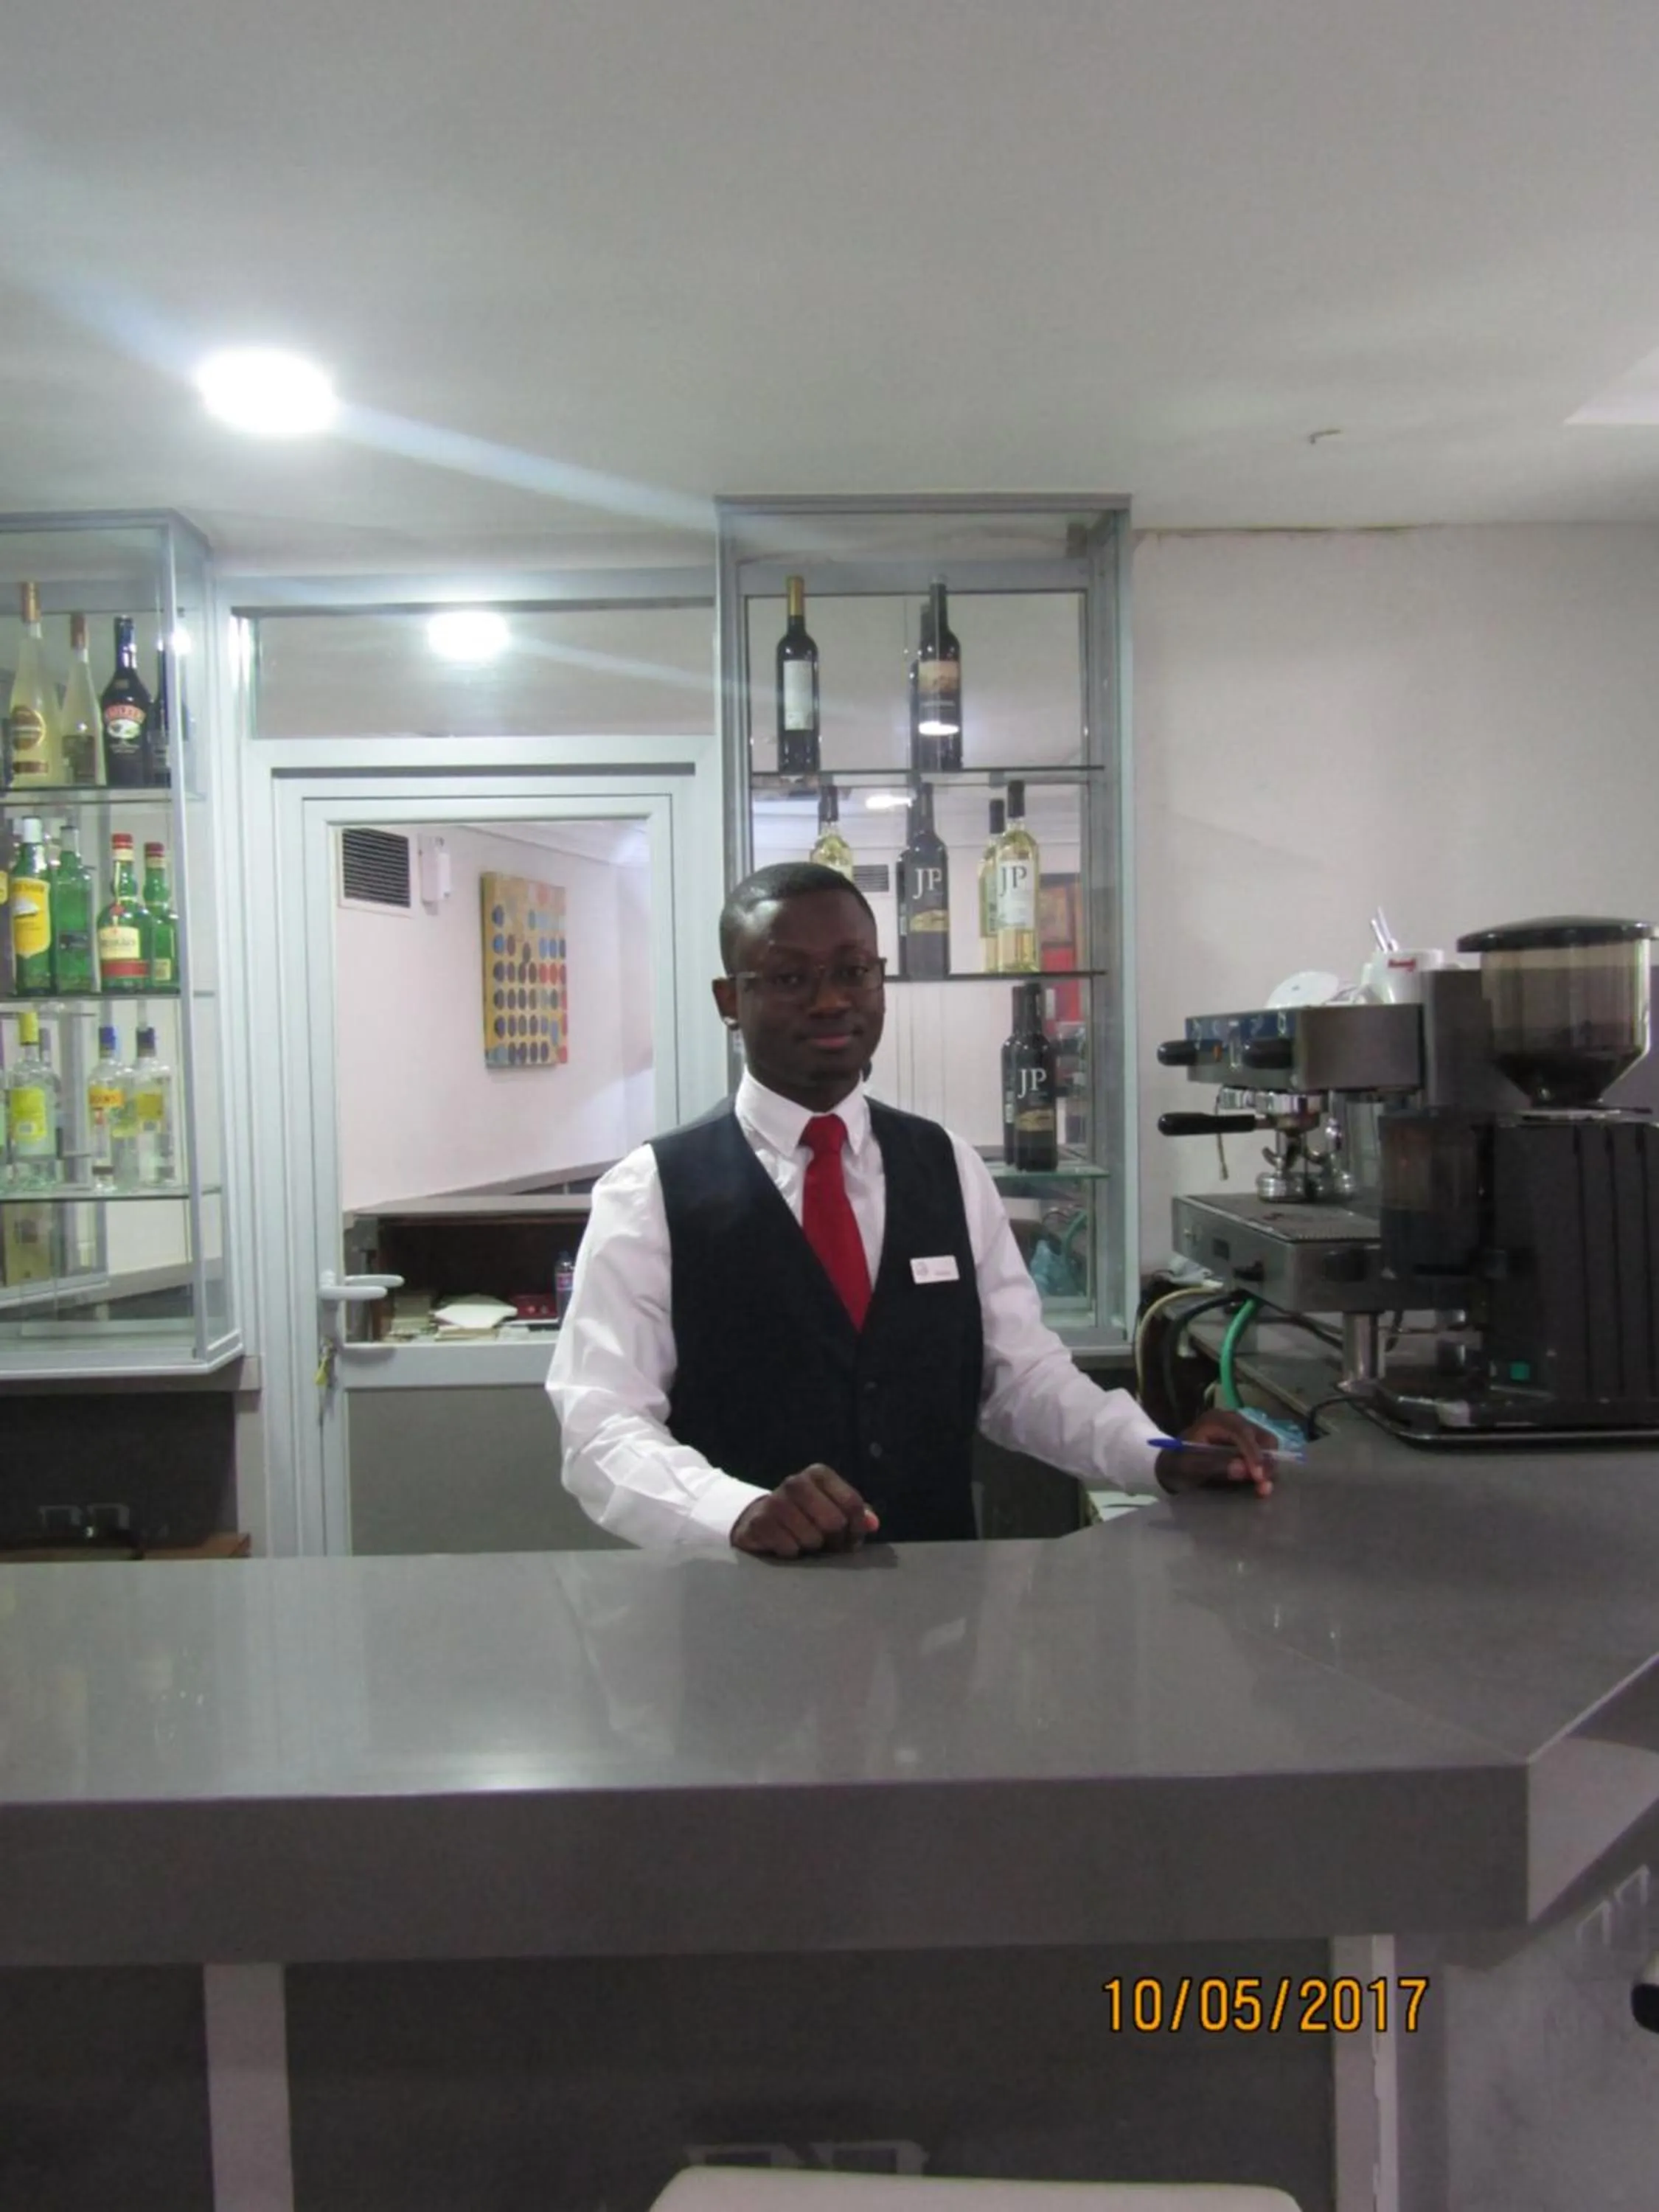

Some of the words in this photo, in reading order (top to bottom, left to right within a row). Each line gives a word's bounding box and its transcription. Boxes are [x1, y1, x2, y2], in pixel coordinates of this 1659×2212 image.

[912, 867, 942, 899] JP
[998, 866, 1027, 897] JP
[1018, 1068, 1047, 1099] JP
